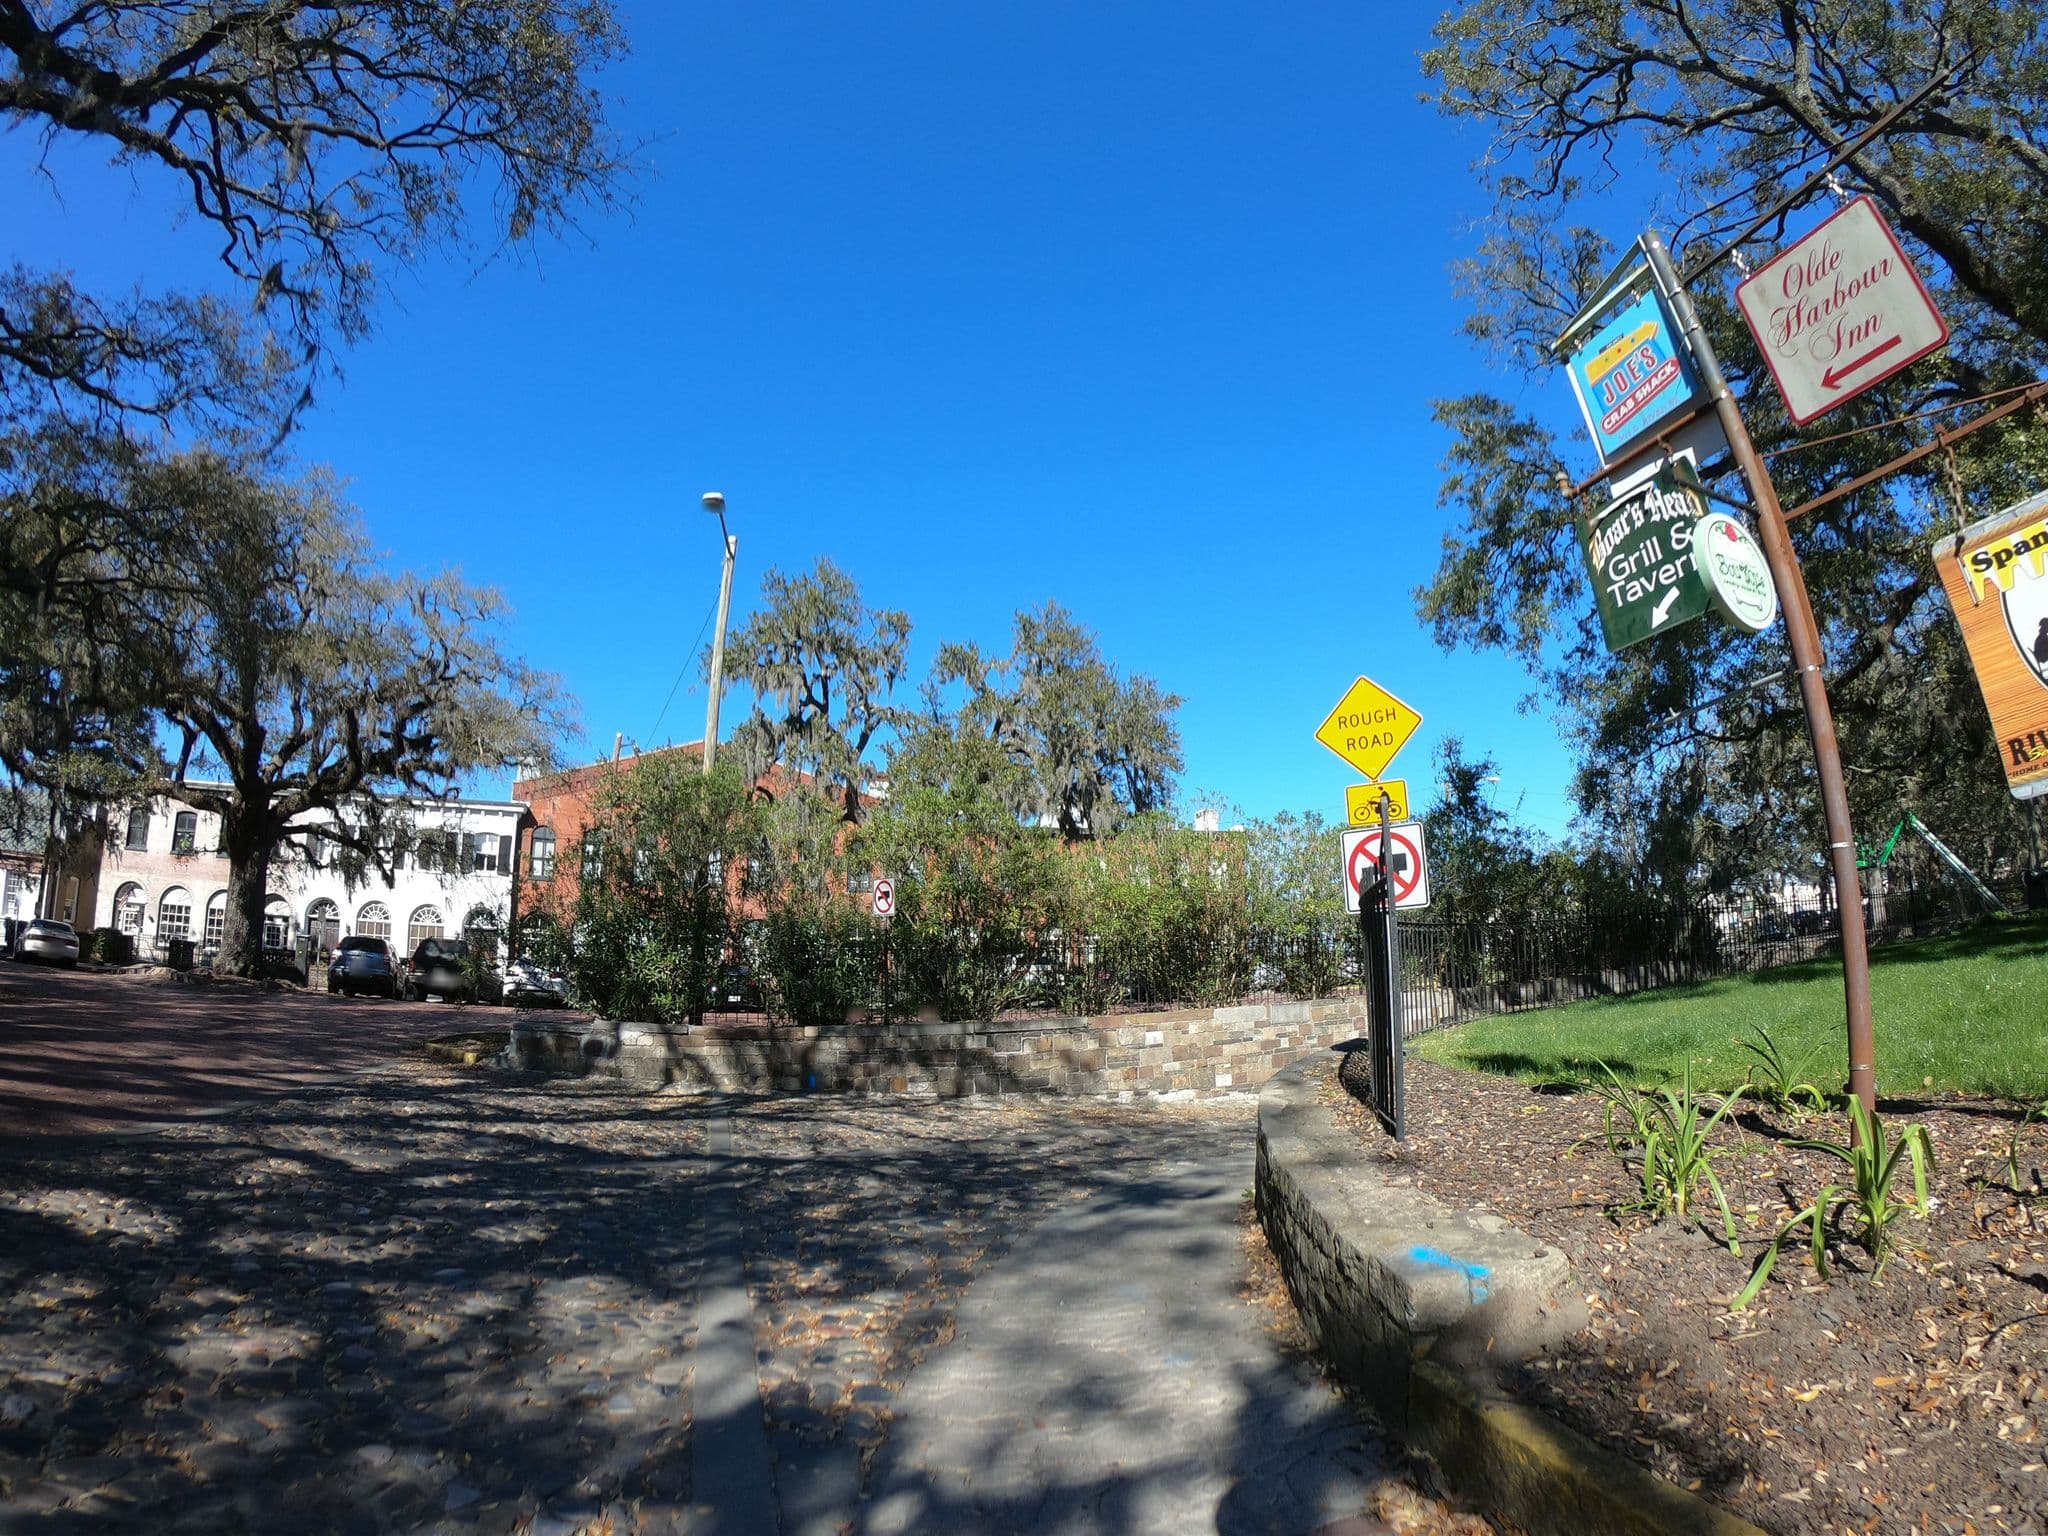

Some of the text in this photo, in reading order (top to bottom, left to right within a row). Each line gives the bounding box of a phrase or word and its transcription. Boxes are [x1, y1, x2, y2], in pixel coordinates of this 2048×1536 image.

[1783, 239, 1843, 299] Olde
[1767, 257, 1895, 357] Harbour
[1808, 312, 1883, 361] Inn
[1603, 345, 1658, 405] JOE'S
[1603, 398, 1635, 429] CRAB
[1634, 362, 1676, 401] SHACK
[1589, 500, 1645, 576] Boar's
[1608, 521, 1694, 582] Grill &
[1971, 521, 2048, 573] Span
[1338, 707, 1396, 730] ROUGH
[1346, 731, 1394, 752] ROAD
